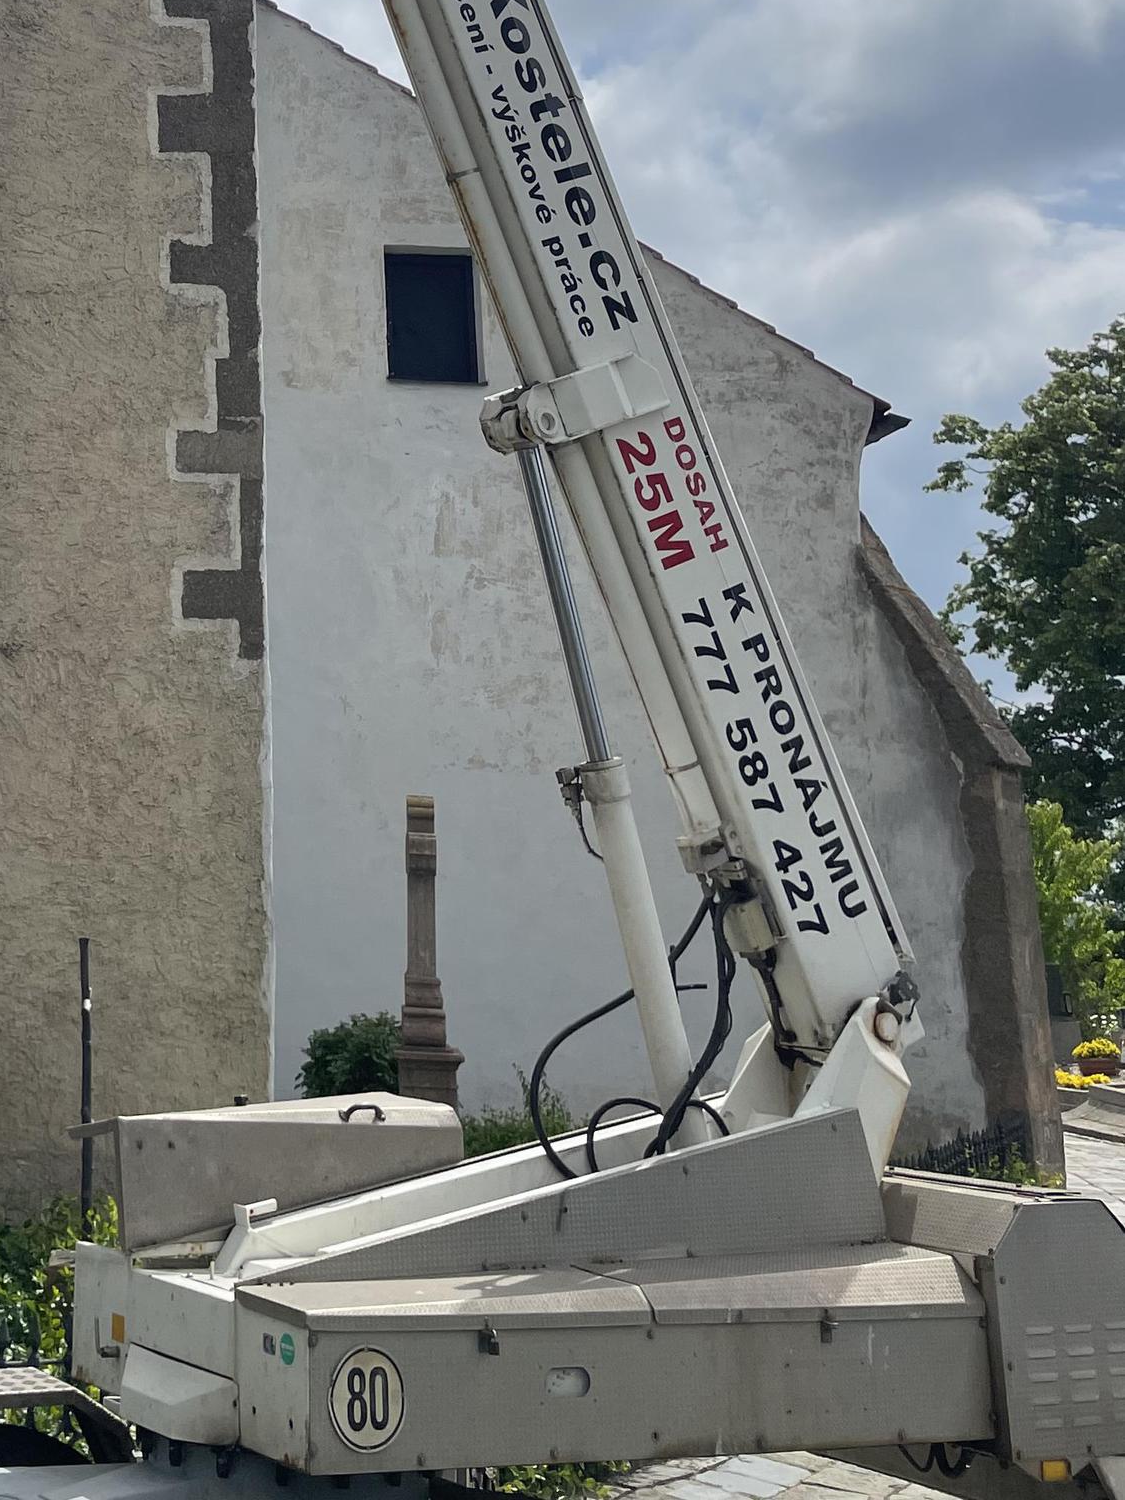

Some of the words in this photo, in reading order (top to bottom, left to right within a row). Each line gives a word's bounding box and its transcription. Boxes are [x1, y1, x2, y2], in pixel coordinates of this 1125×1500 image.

[491, 83, 557, 225] výškové
[541, 235, 595, 338] práce
[616, 431, 696, 571] 25M
[663, 416, 729, 553] DOSAH
[682, 597, 740, 695] 777
[725, 717, 785, 814] 587
[772, 839, 830, 935] 427
[722, 582, 756, 623] K
[742, 632, 867, 918] PRONÁJMU
[347, 1366, 389, 1431] 80
